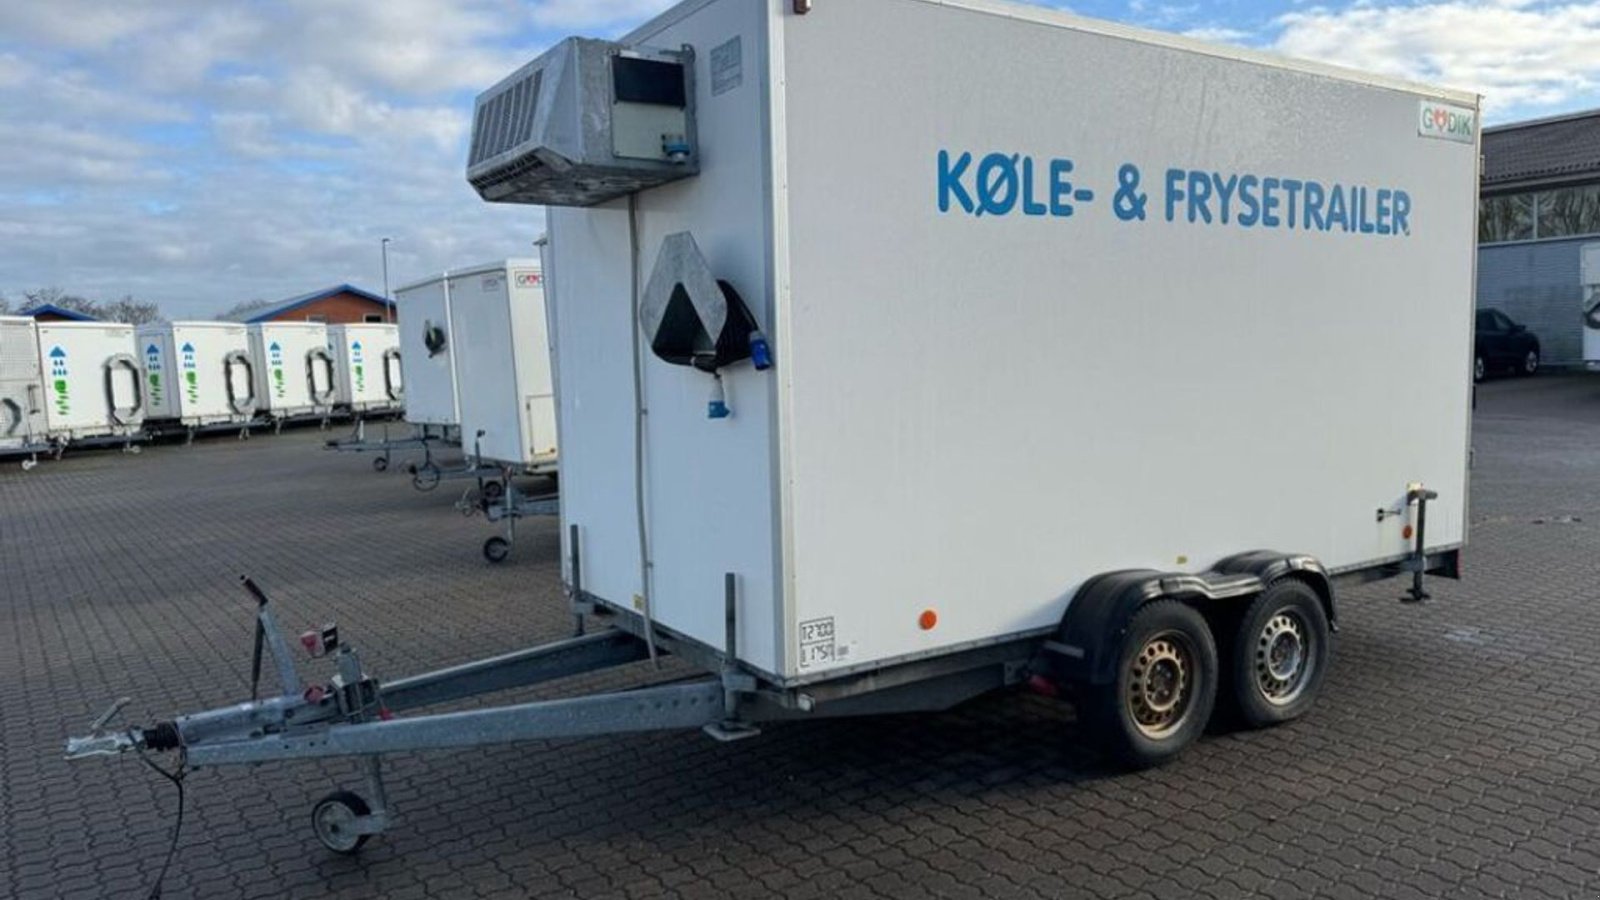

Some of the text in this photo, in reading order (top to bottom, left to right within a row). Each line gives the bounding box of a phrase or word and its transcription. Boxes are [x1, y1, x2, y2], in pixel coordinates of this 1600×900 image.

[937, 149, 1410, 236] KØLE- & FRYSETRAILER
